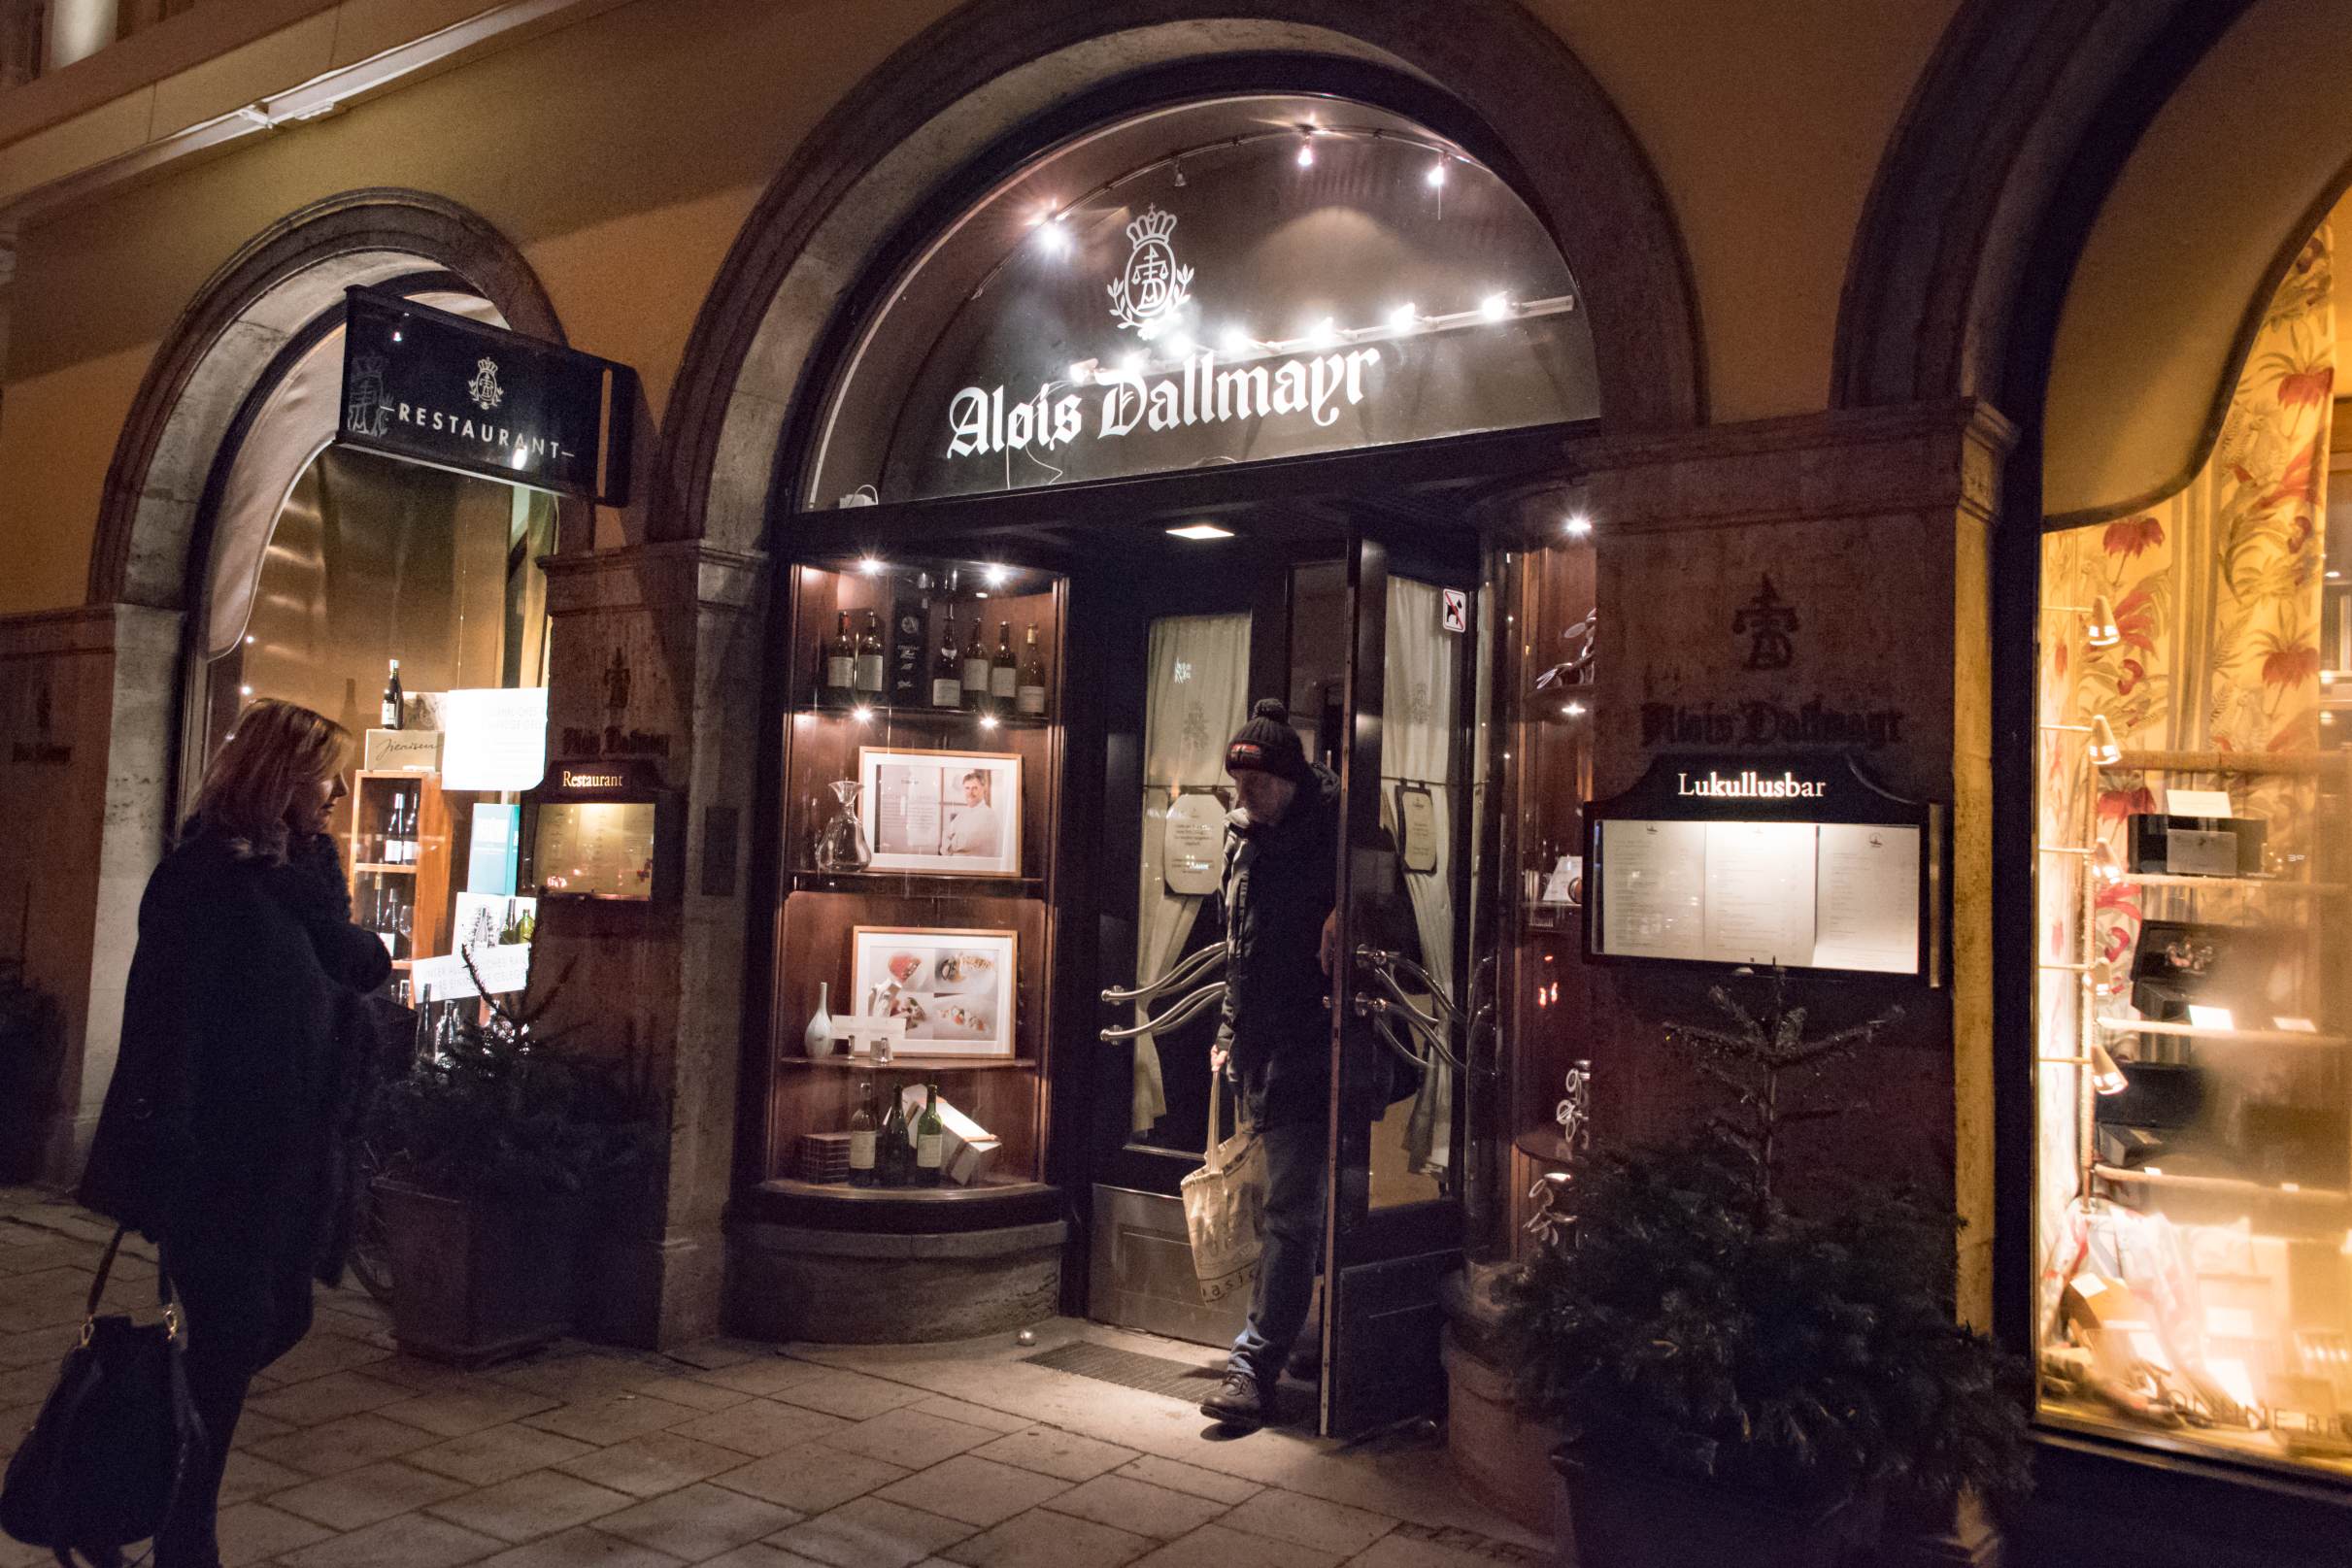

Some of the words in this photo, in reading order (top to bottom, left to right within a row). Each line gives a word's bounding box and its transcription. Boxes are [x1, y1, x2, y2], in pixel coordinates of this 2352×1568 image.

[946, 383, 1083, 459] Alois
[1095, 347, 1381, 440] Dallmayr
[398, 402, 560, 459] RESTAURANT
[562, 770, 622, 787] Restaurant
[1678, 772, 1826, 798] Lukullusbar
